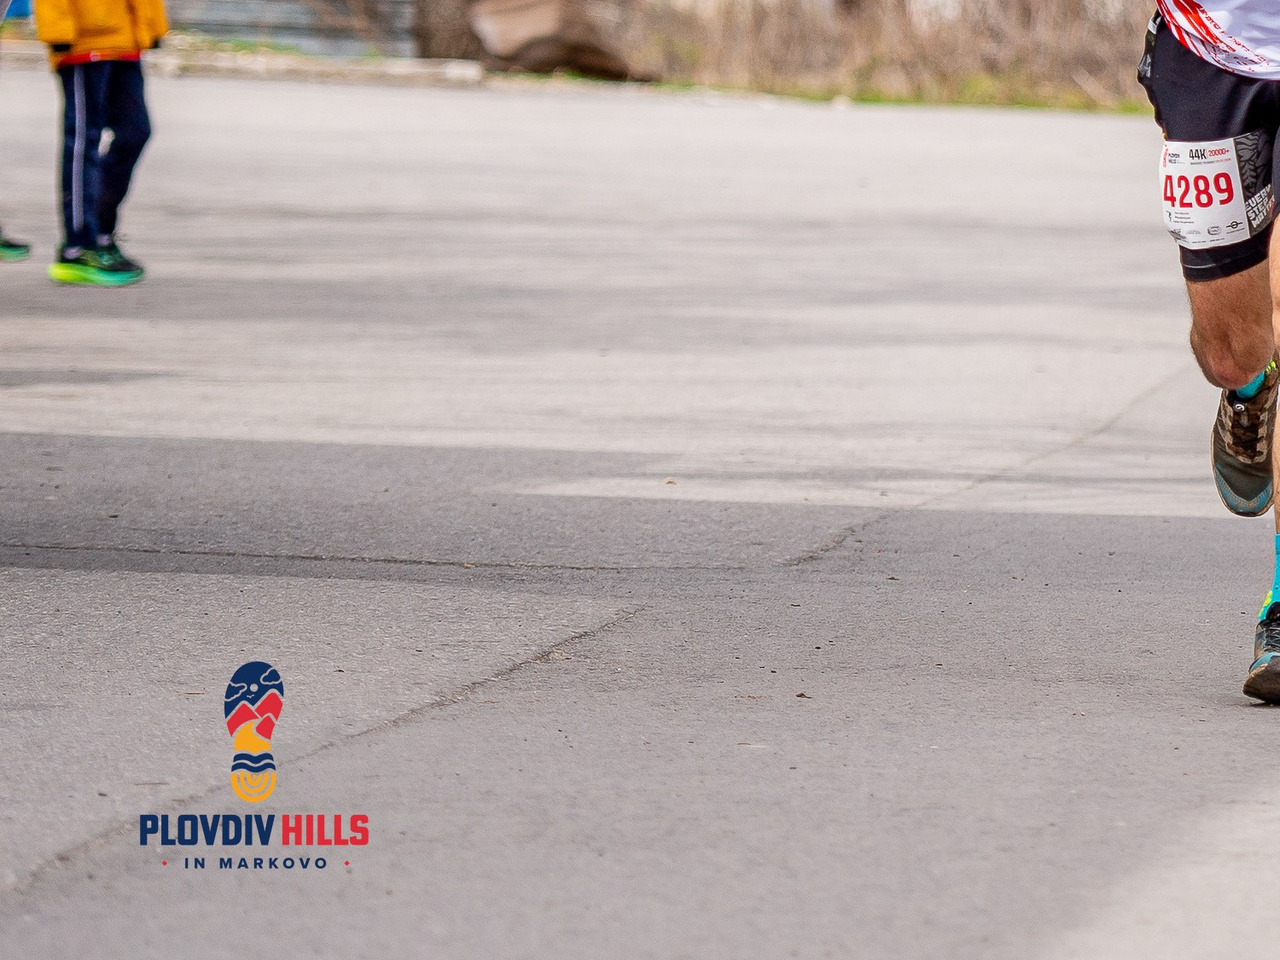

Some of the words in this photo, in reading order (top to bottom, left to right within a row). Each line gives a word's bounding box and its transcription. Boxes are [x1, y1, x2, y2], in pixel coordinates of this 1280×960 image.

[1189, 148, 1207, 160] 44K
[1163, 172, 1234, 208] 4289
[1247, 197, 1269, 220] STEP
